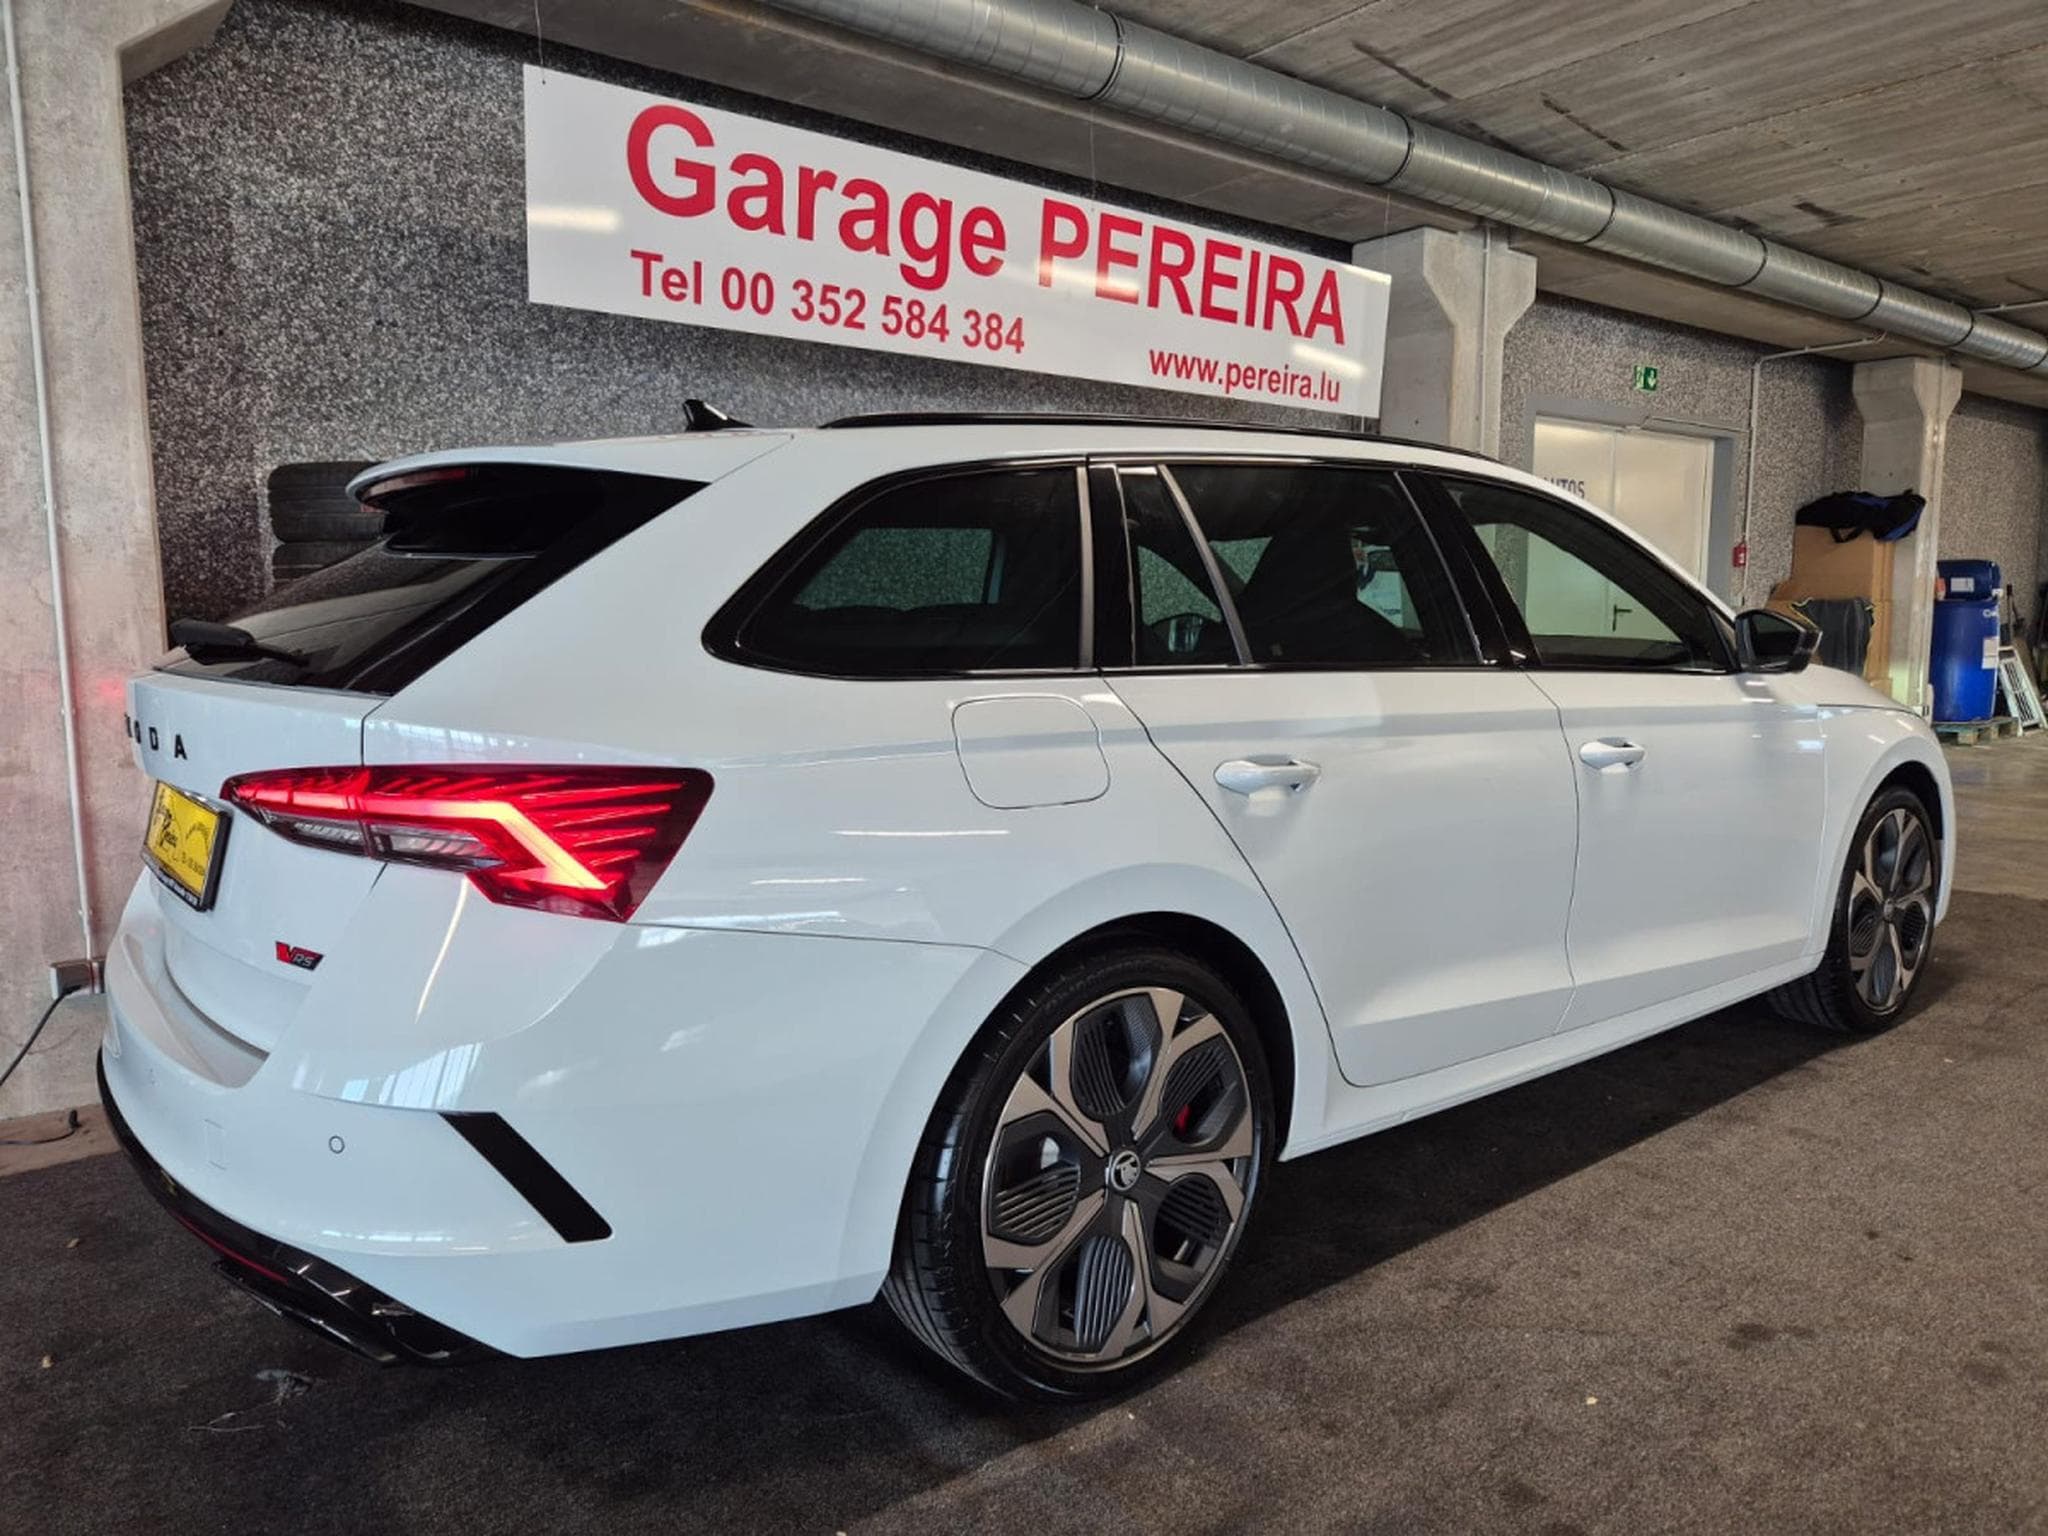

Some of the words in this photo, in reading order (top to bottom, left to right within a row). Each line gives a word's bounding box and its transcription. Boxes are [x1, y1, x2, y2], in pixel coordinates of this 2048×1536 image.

[626, 103, 1009, 293] Garage
[1038, 196, 1346, 347] PEREIRA
[629, 248, 704, 305] Tel
[719, 265, 776, 317] 00
[789, 277, 869, 332] 352
[880, 294, 951, 345] 584
[961, 308, 1026, 354] 384
[1148, 350, 1341, 404] www.pereira.lu
[1543, 477, 1585, 499] TOS
